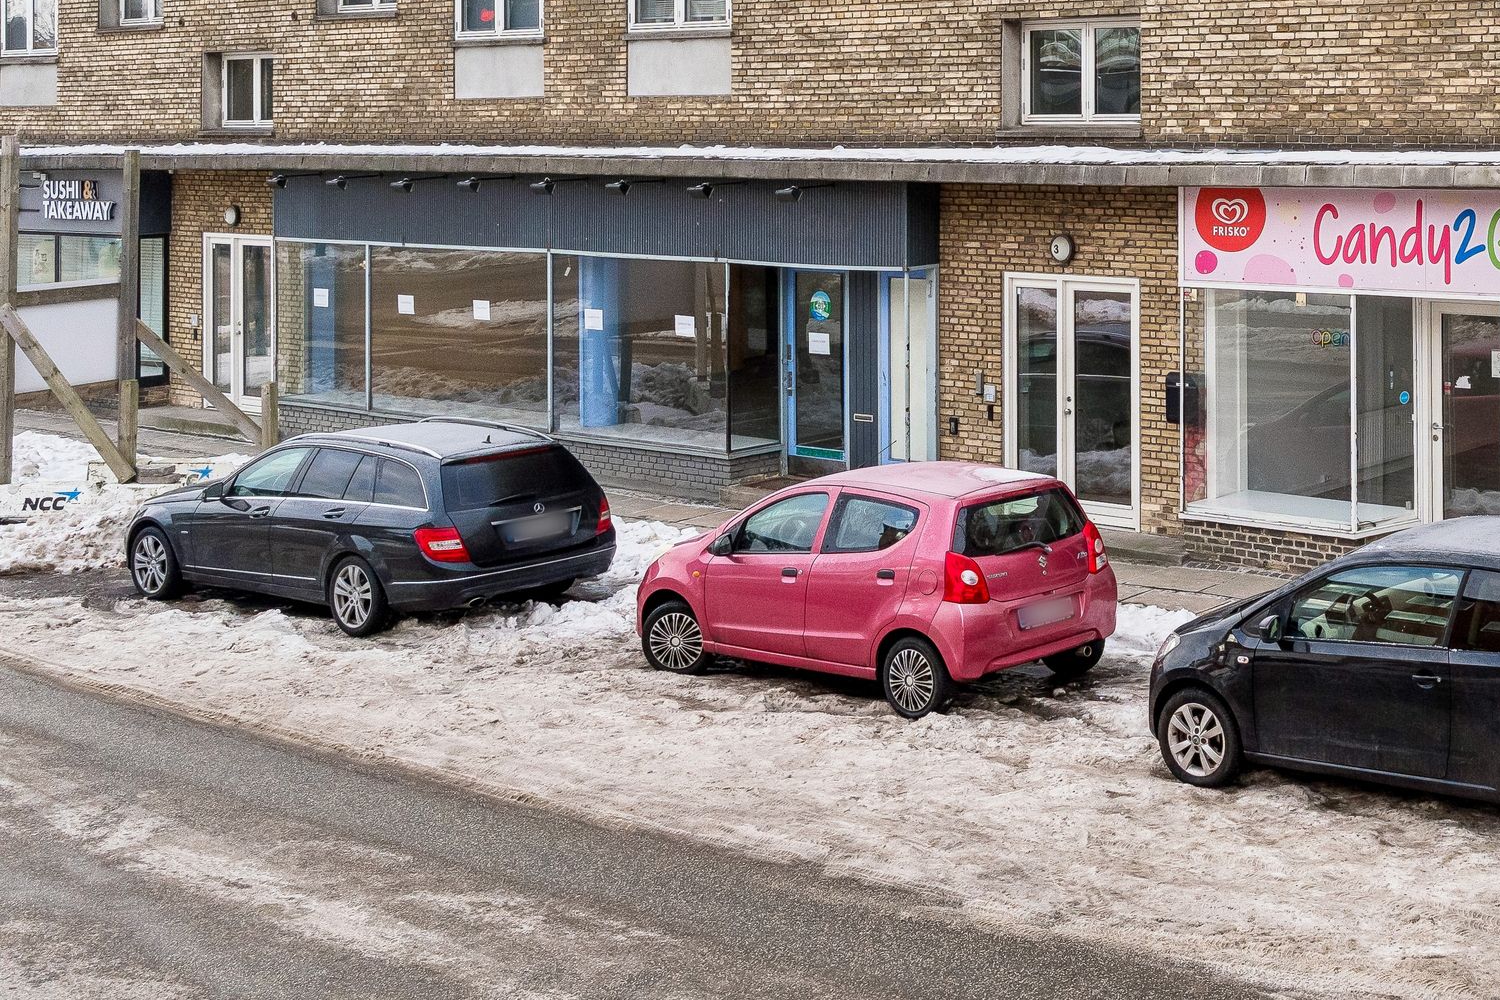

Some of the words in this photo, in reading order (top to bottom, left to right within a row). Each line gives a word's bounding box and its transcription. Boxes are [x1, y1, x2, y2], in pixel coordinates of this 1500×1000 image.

[43, 180, 79, 199] SUSHI
[82, 180, 95, 200] &
[42, 200, 112, 220] TAKEAWAY
[1212, 225, 1247, 237] FRISKO
[1053, 244, 1059, 254] 3
[22, 496, 66, 511] NCC
